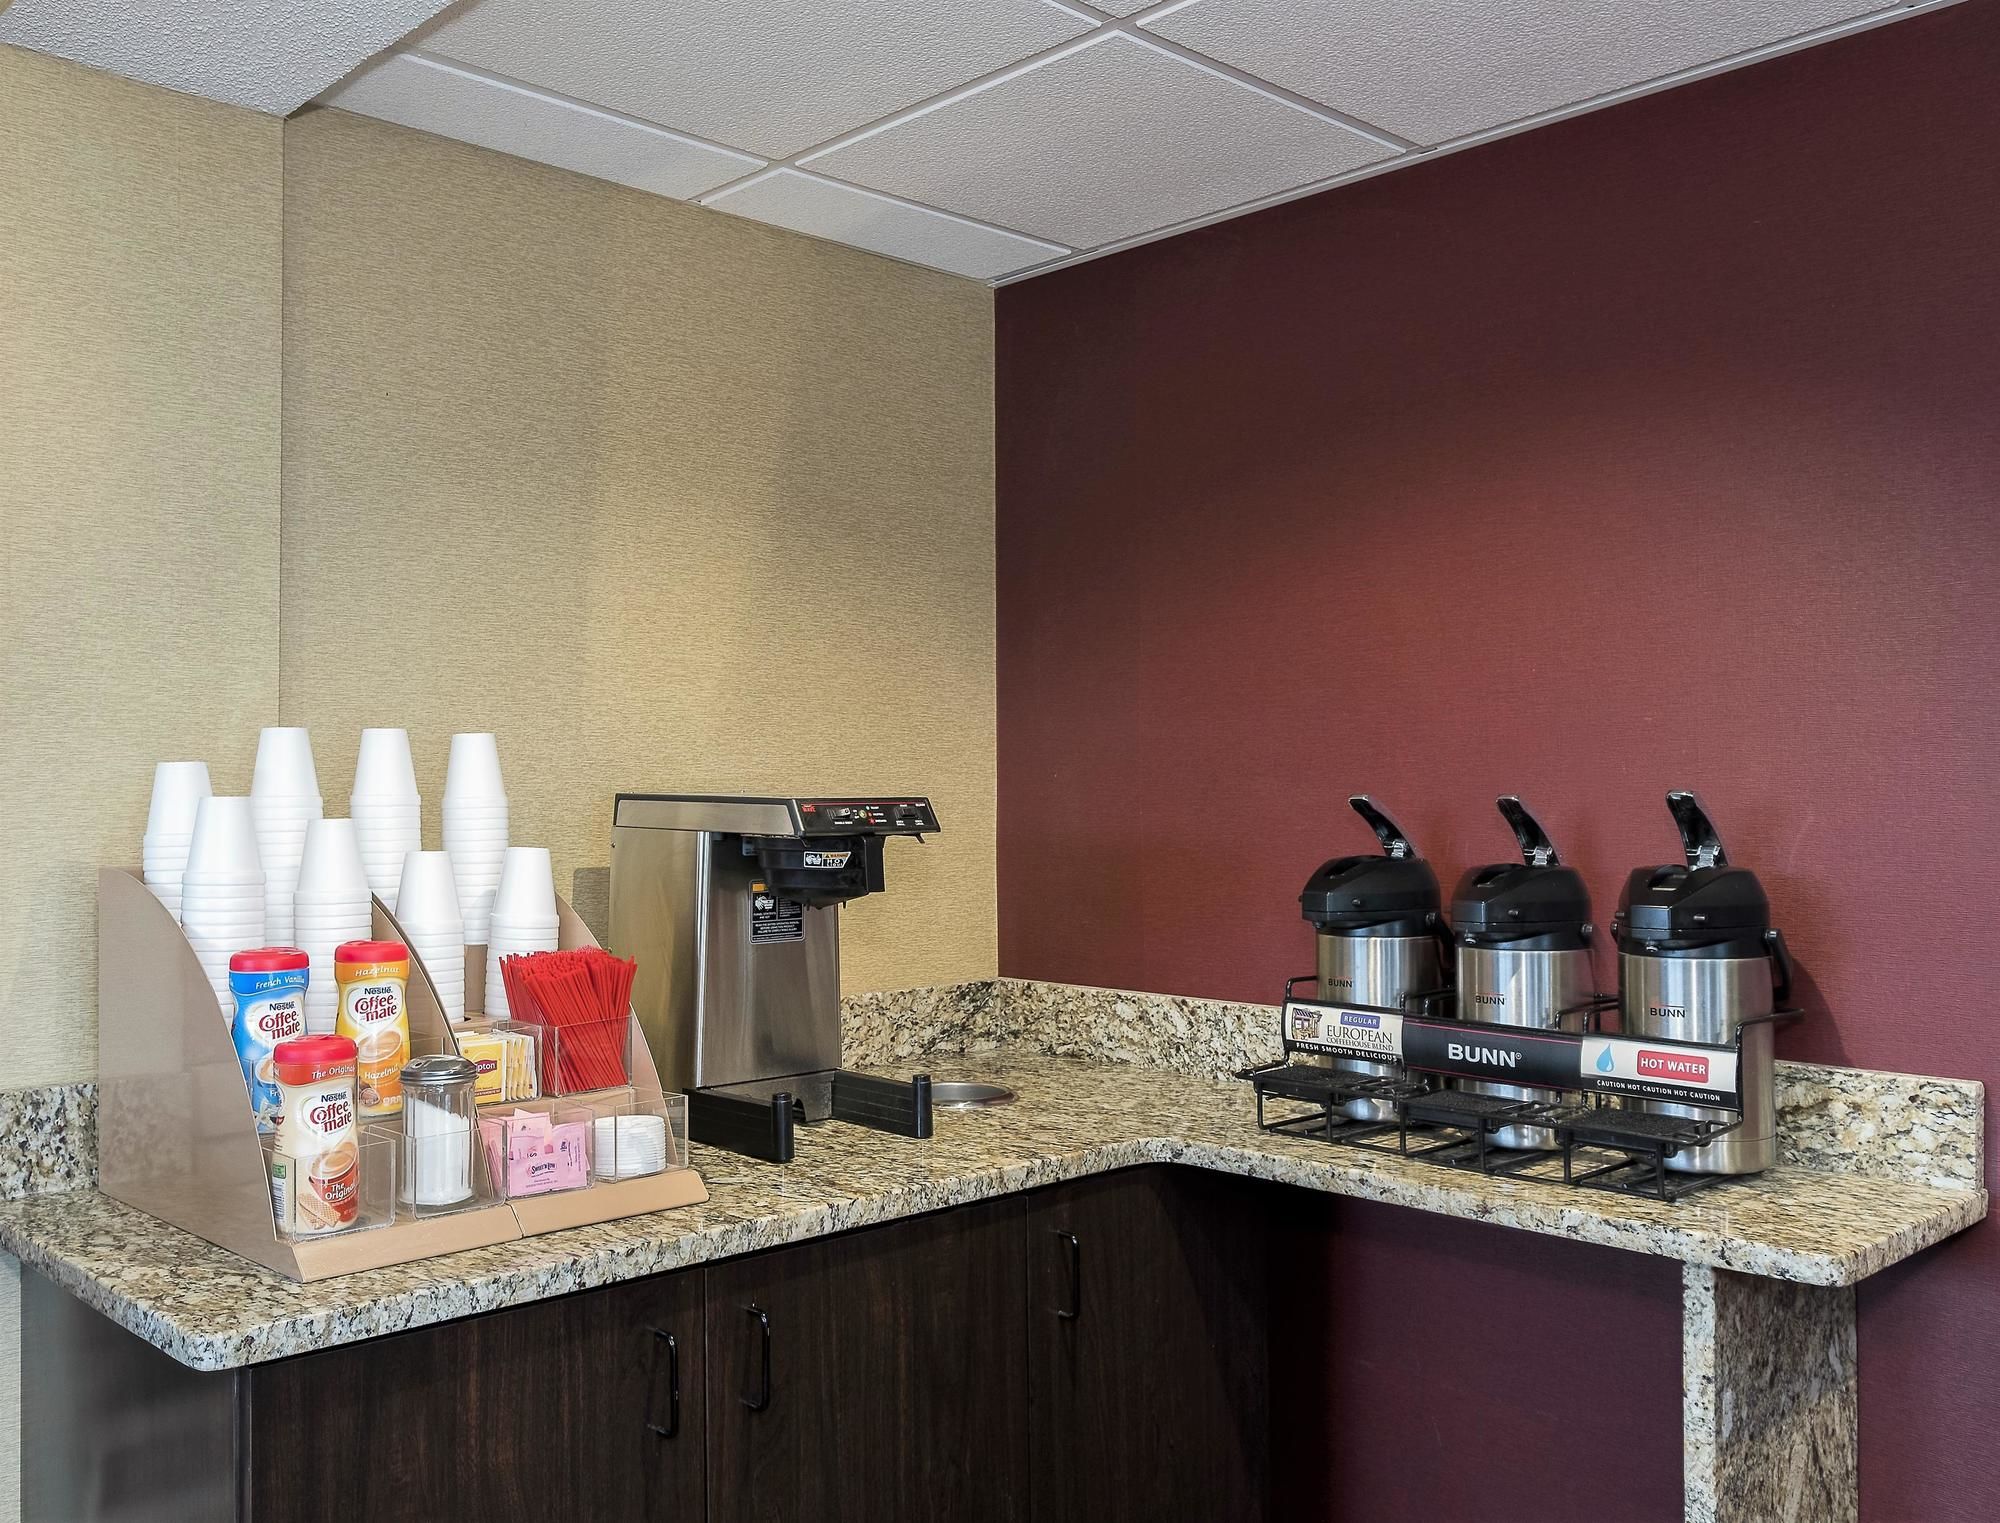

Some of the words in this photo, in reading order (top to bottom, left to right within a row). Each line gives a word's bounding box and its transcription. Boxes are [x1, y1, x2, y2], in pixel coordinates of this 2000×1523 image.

[256, 977, 281, 989] French
[1328, 979, 1353, 988] BUNN
[1475, 995, 1505, 1005] BUNN
[365, 1004, 397, 1021] mate
[1343, 1015, 1377, 1025] REGULAR
[1650, 1007, 1686, 1018] BUNN
[272, 1021, 300, 1039] mate
[1327, 1024, 1393, 1044] EUROPEAN
[1326, 1037, 1372, 1049] COFFEEHOUSE
[1372, 1043, 1394, 1051] BLEND
[1296, 1042, 1320, 1051] FRESH
[1321, 1045, 1353, 1056] SMOOTH
[1355, 1050, 1398, 1062] DELICIOUS
[364, 1063, 399, 1080] Hazelnut
[1641, 1057, 1664, 1069] HOT
[1667, 1061, 1706, 1075] WATER
[311, 1069, 327, 1080] The
[1596, 1079, 1626, 1089] CAUTION
[1627, 1083, 1641, 1091] HOT
[1642, 1086, 1672, 1095] CAUTION
[1673, 1089, 1688, 1097] HOT
[1689, 1092, 1720, 1101] CAUTION
[322, 1111, 352, 1133] mate
[332, 1183, 345, 1192] The
